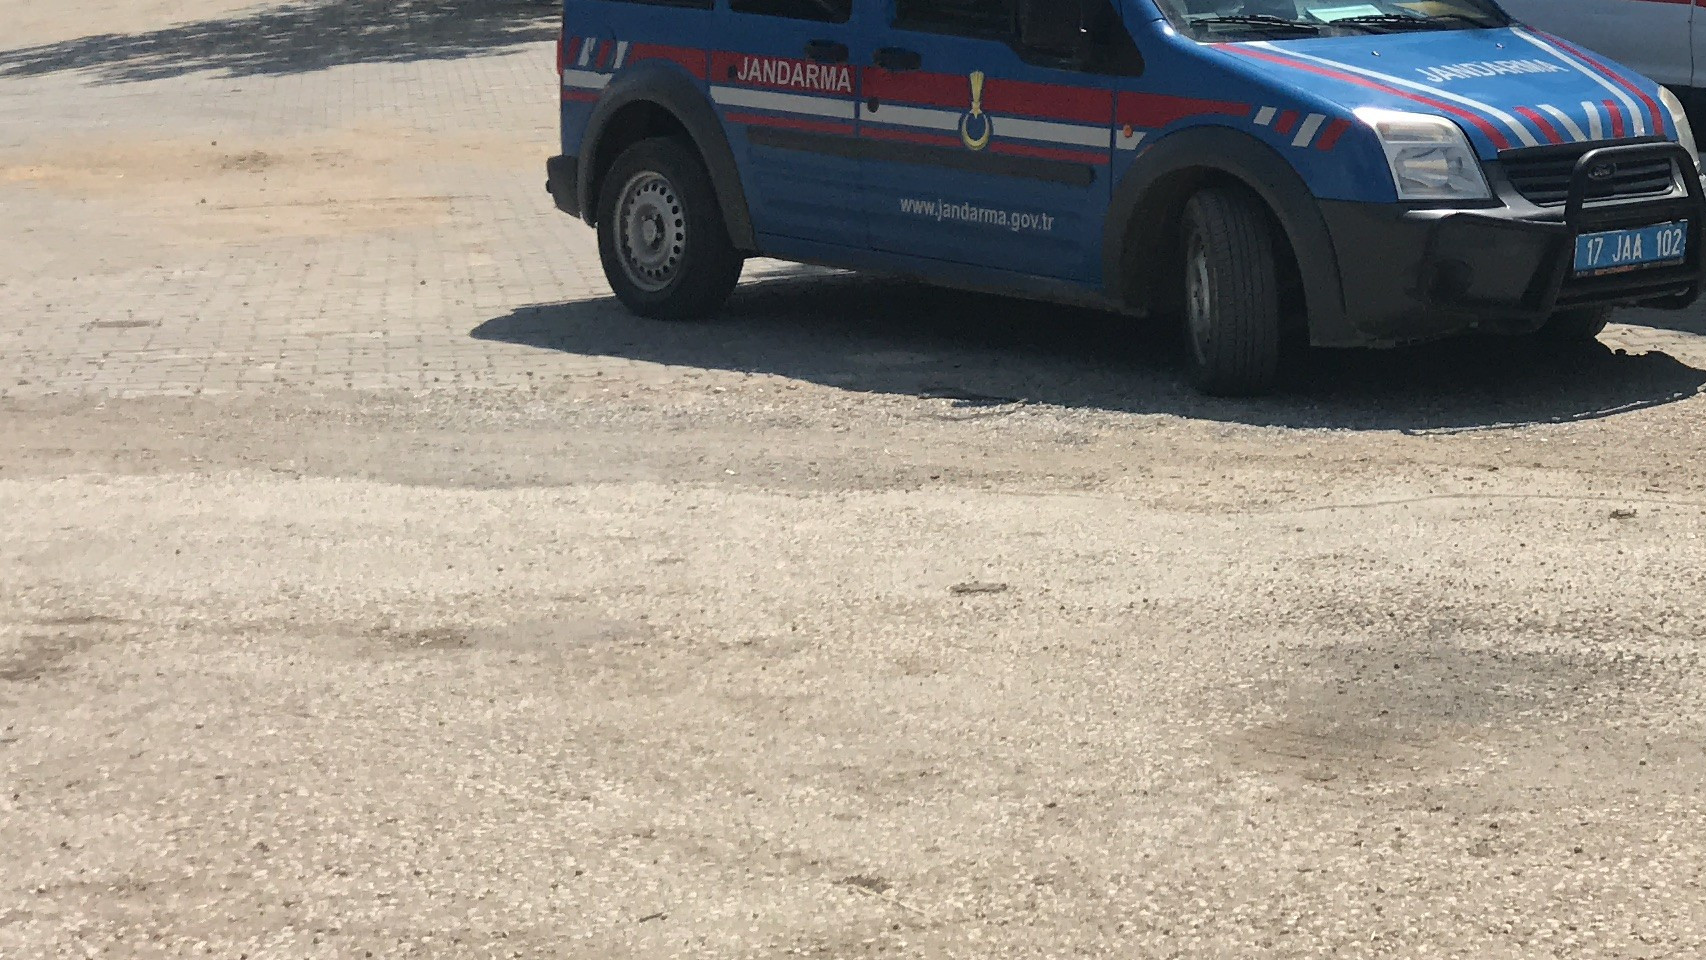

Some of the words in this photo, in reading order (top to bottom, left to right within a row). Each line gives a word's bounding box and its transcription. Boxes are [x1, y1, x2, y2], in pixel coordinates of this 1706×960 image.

[738, 56, 852, 93] JANDARMA
[1415, 59, 1570, 83] JANDARMA
[900, 198, 1055, 232] www.jandarma.gov.tr
[1587, 237, 1604, 266] 17
[1612, 232, 1642, 262] JAA
[1656, 229, 1682, 257] 102
